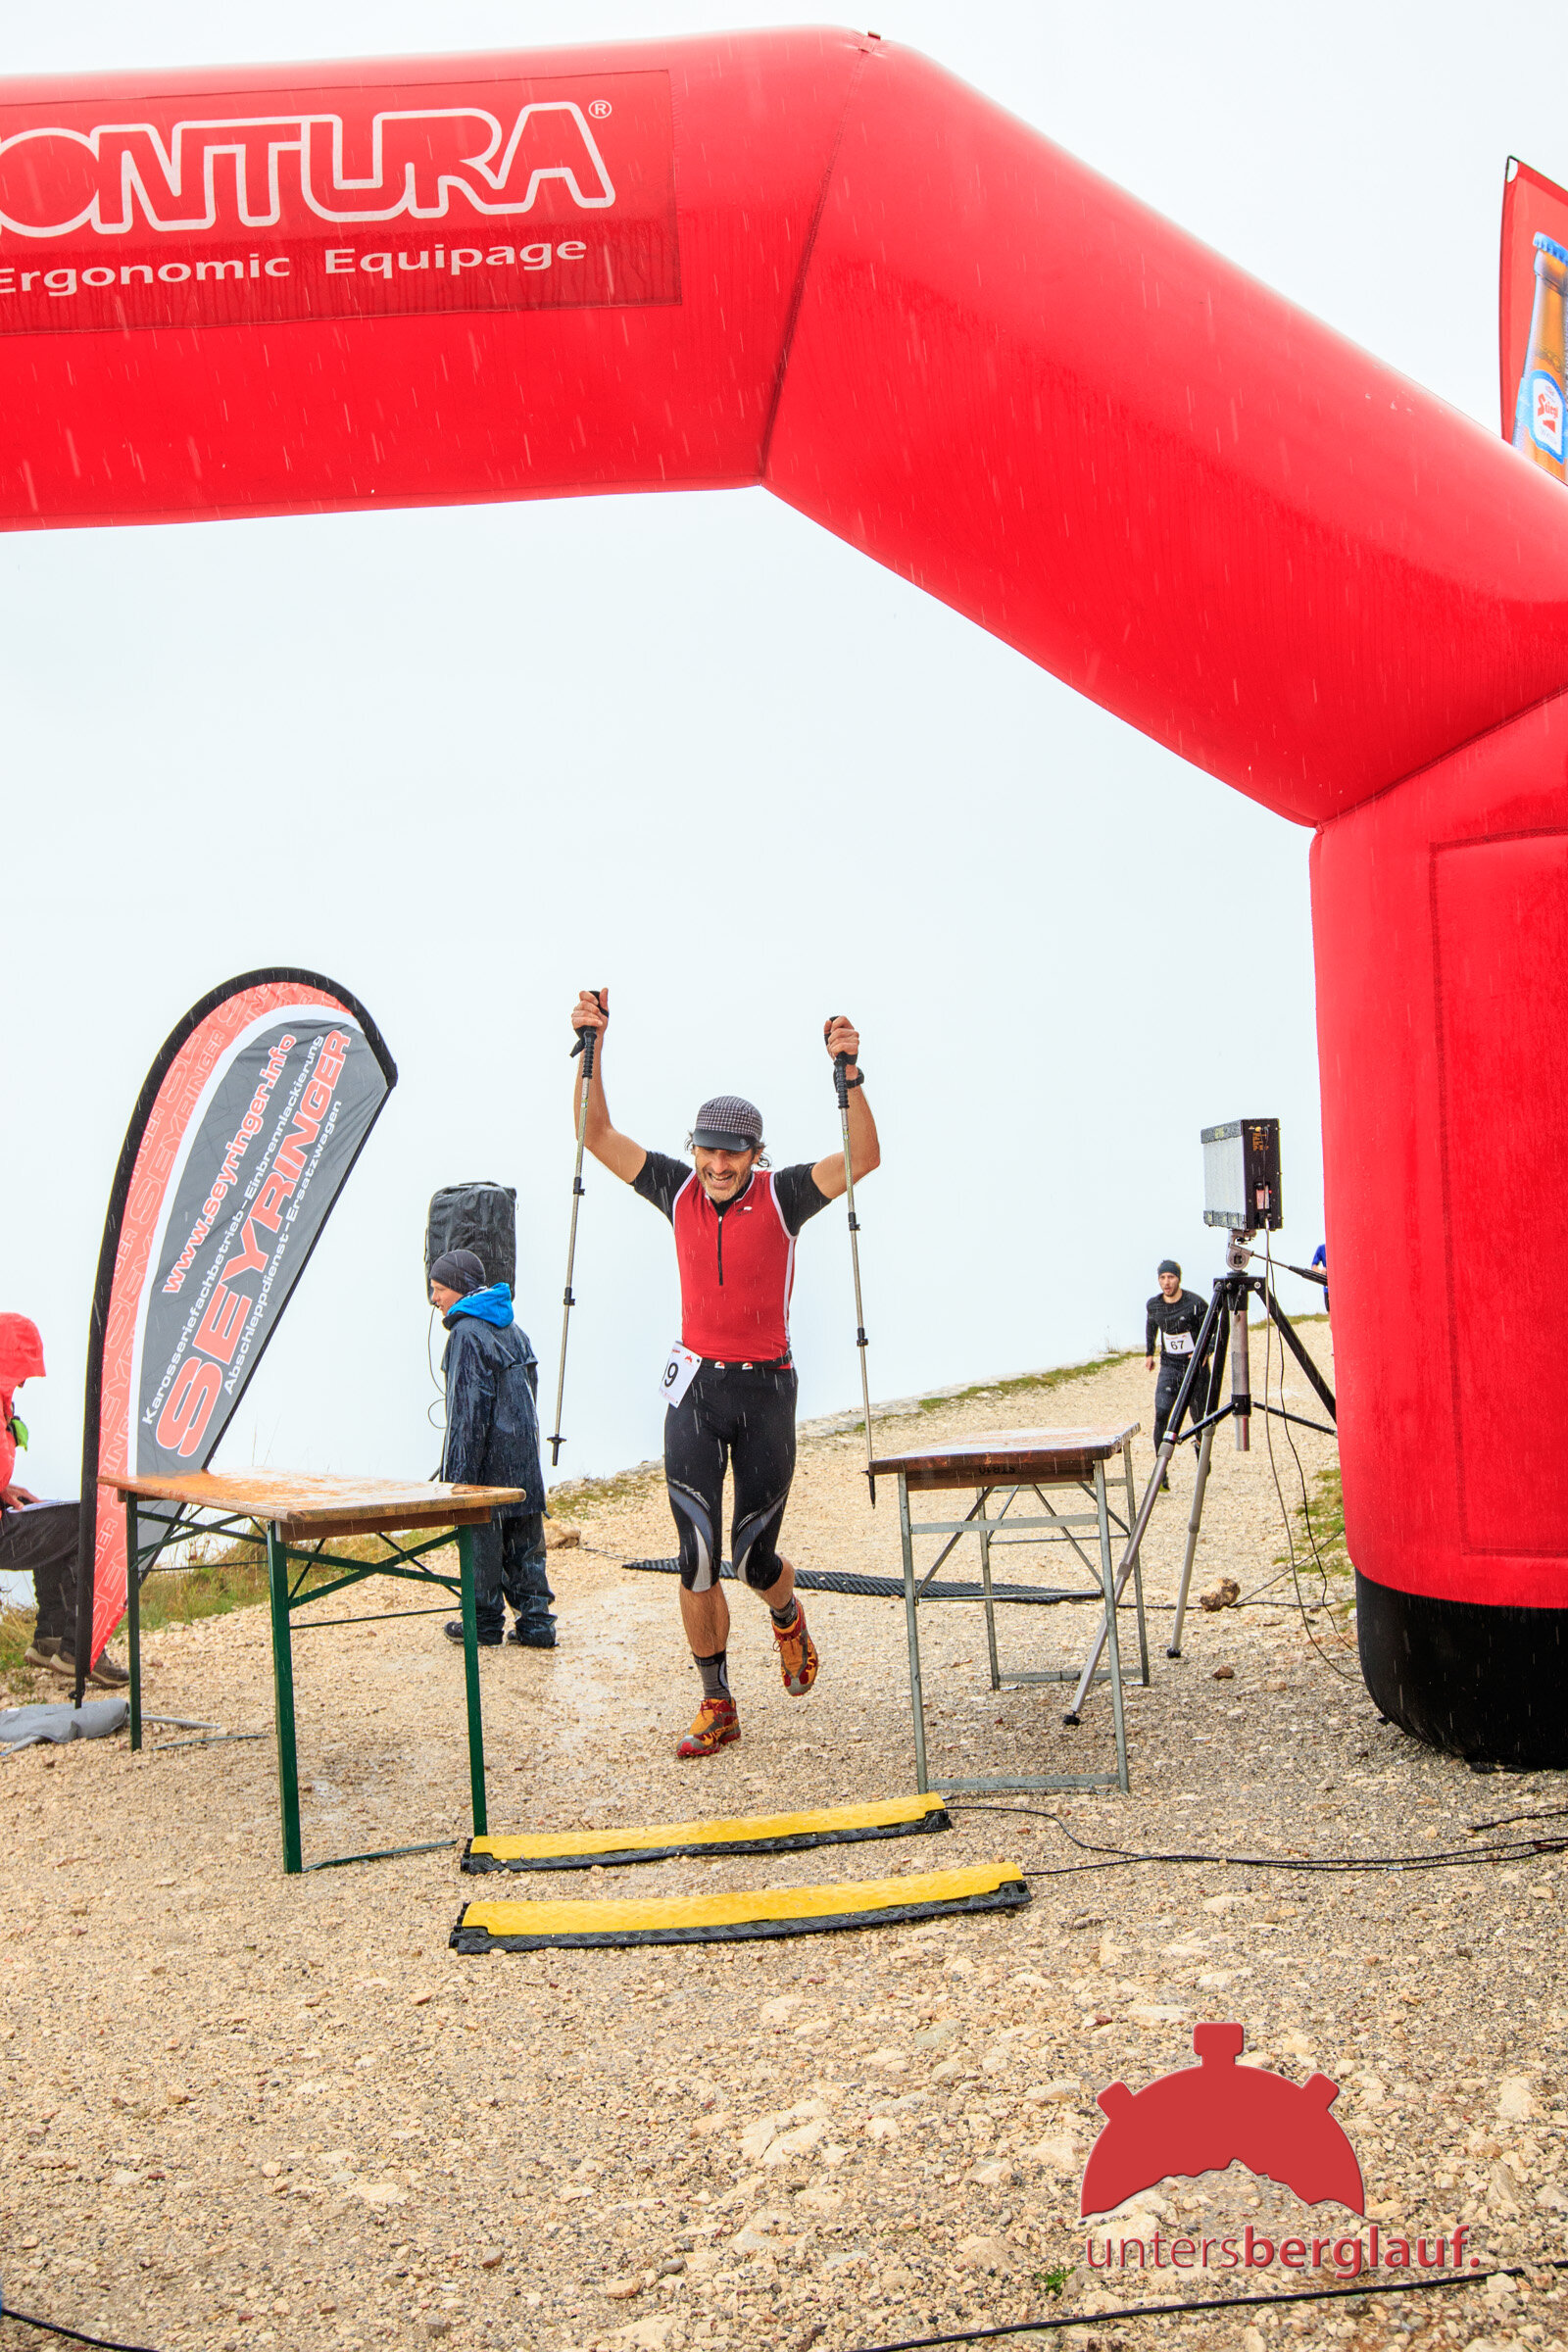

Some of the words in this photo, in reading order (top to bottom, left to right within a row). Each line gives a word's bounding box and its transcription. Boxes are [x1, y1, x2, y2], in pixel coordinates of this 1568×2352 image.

[0, 253, 291, 297] Ergonomic
[324, 238, 587, 279] Equipage
[161, 1034, 297, 1295] www.seyringer.info
[155, 1029, 352, 1458] SEYRINGER
[662, 1360, 679, 1388] 9
[1170, 1340, 1184, 1350] 67
